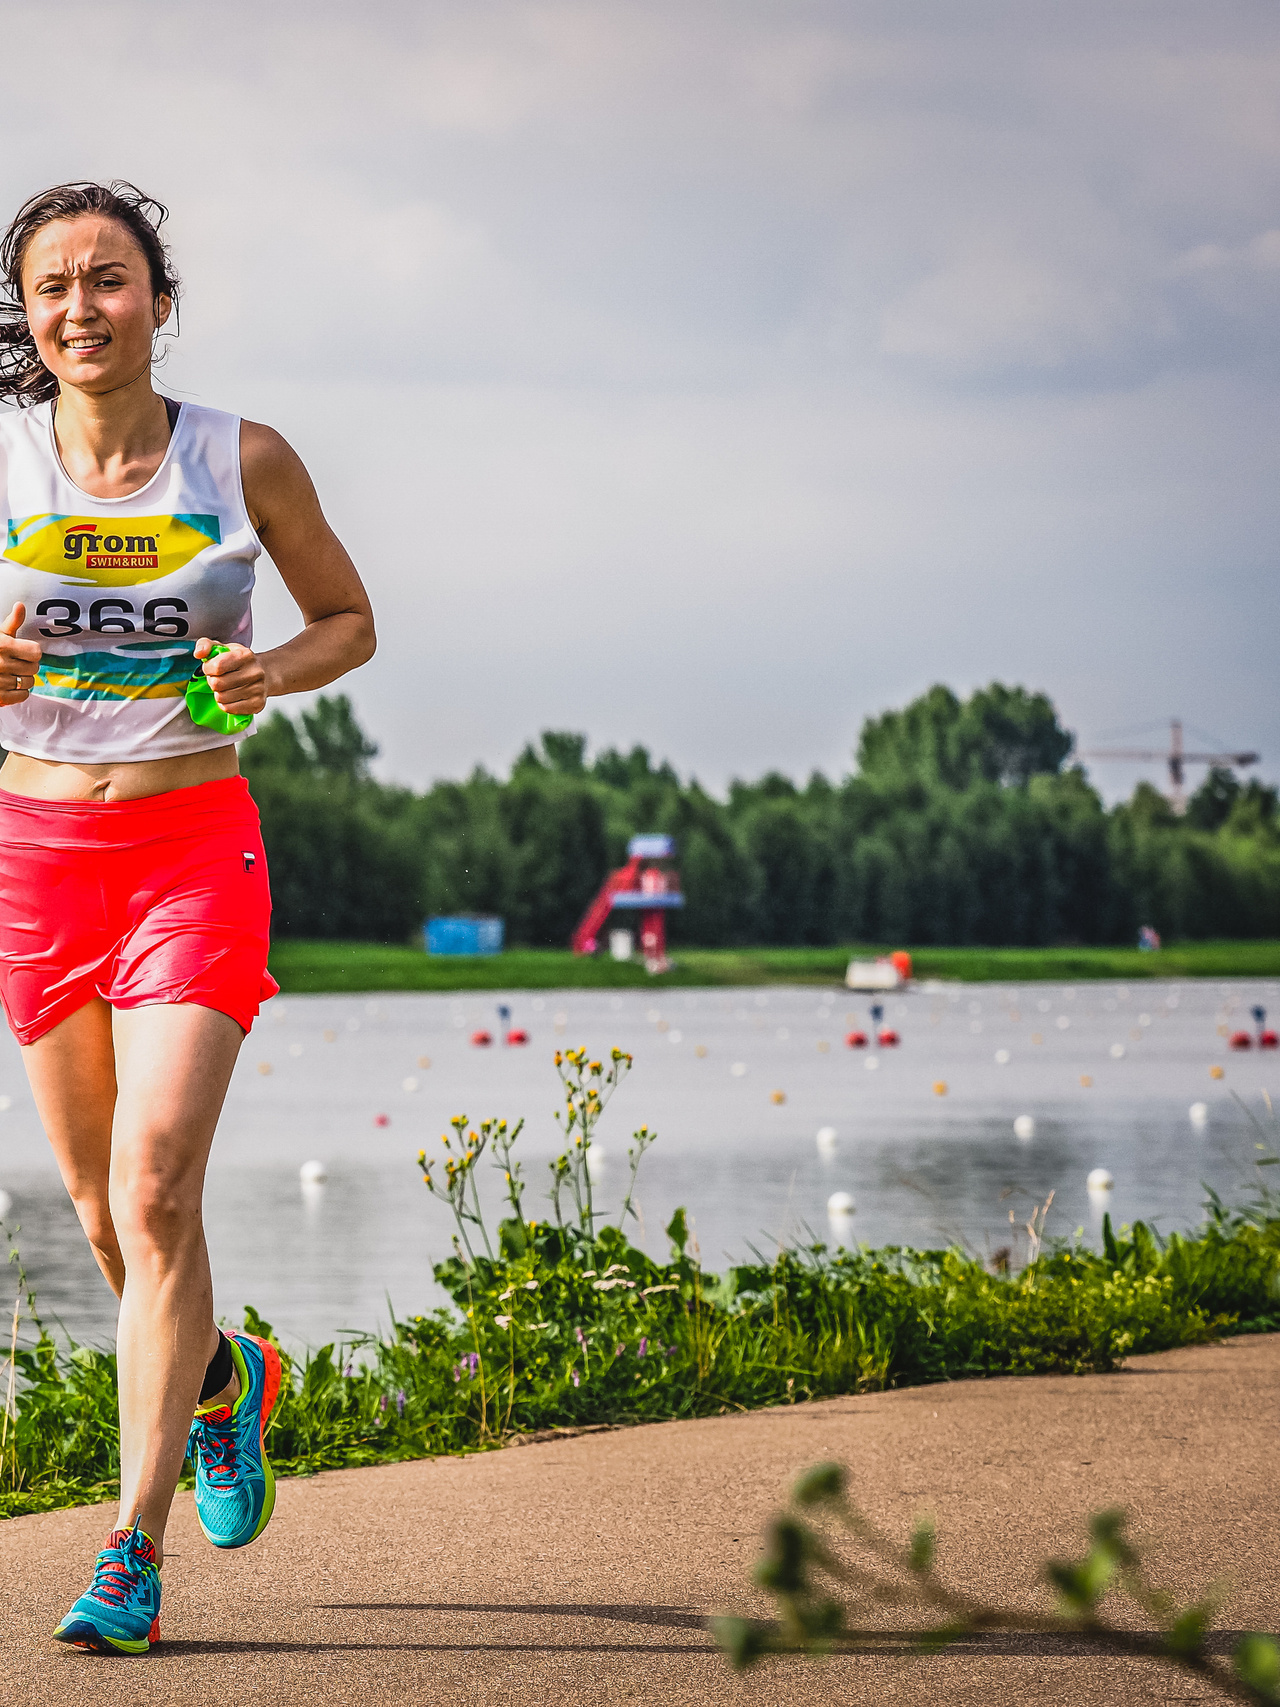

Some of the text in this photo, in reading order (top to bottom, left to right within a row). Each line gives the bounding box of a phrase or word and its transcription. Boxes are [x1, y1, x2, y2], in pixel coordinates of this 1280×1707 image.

[64, 532, 158, 560] grom
[90, 556, 154, 567] SWIM&RUN
[35, 597, 189, 638] 366
